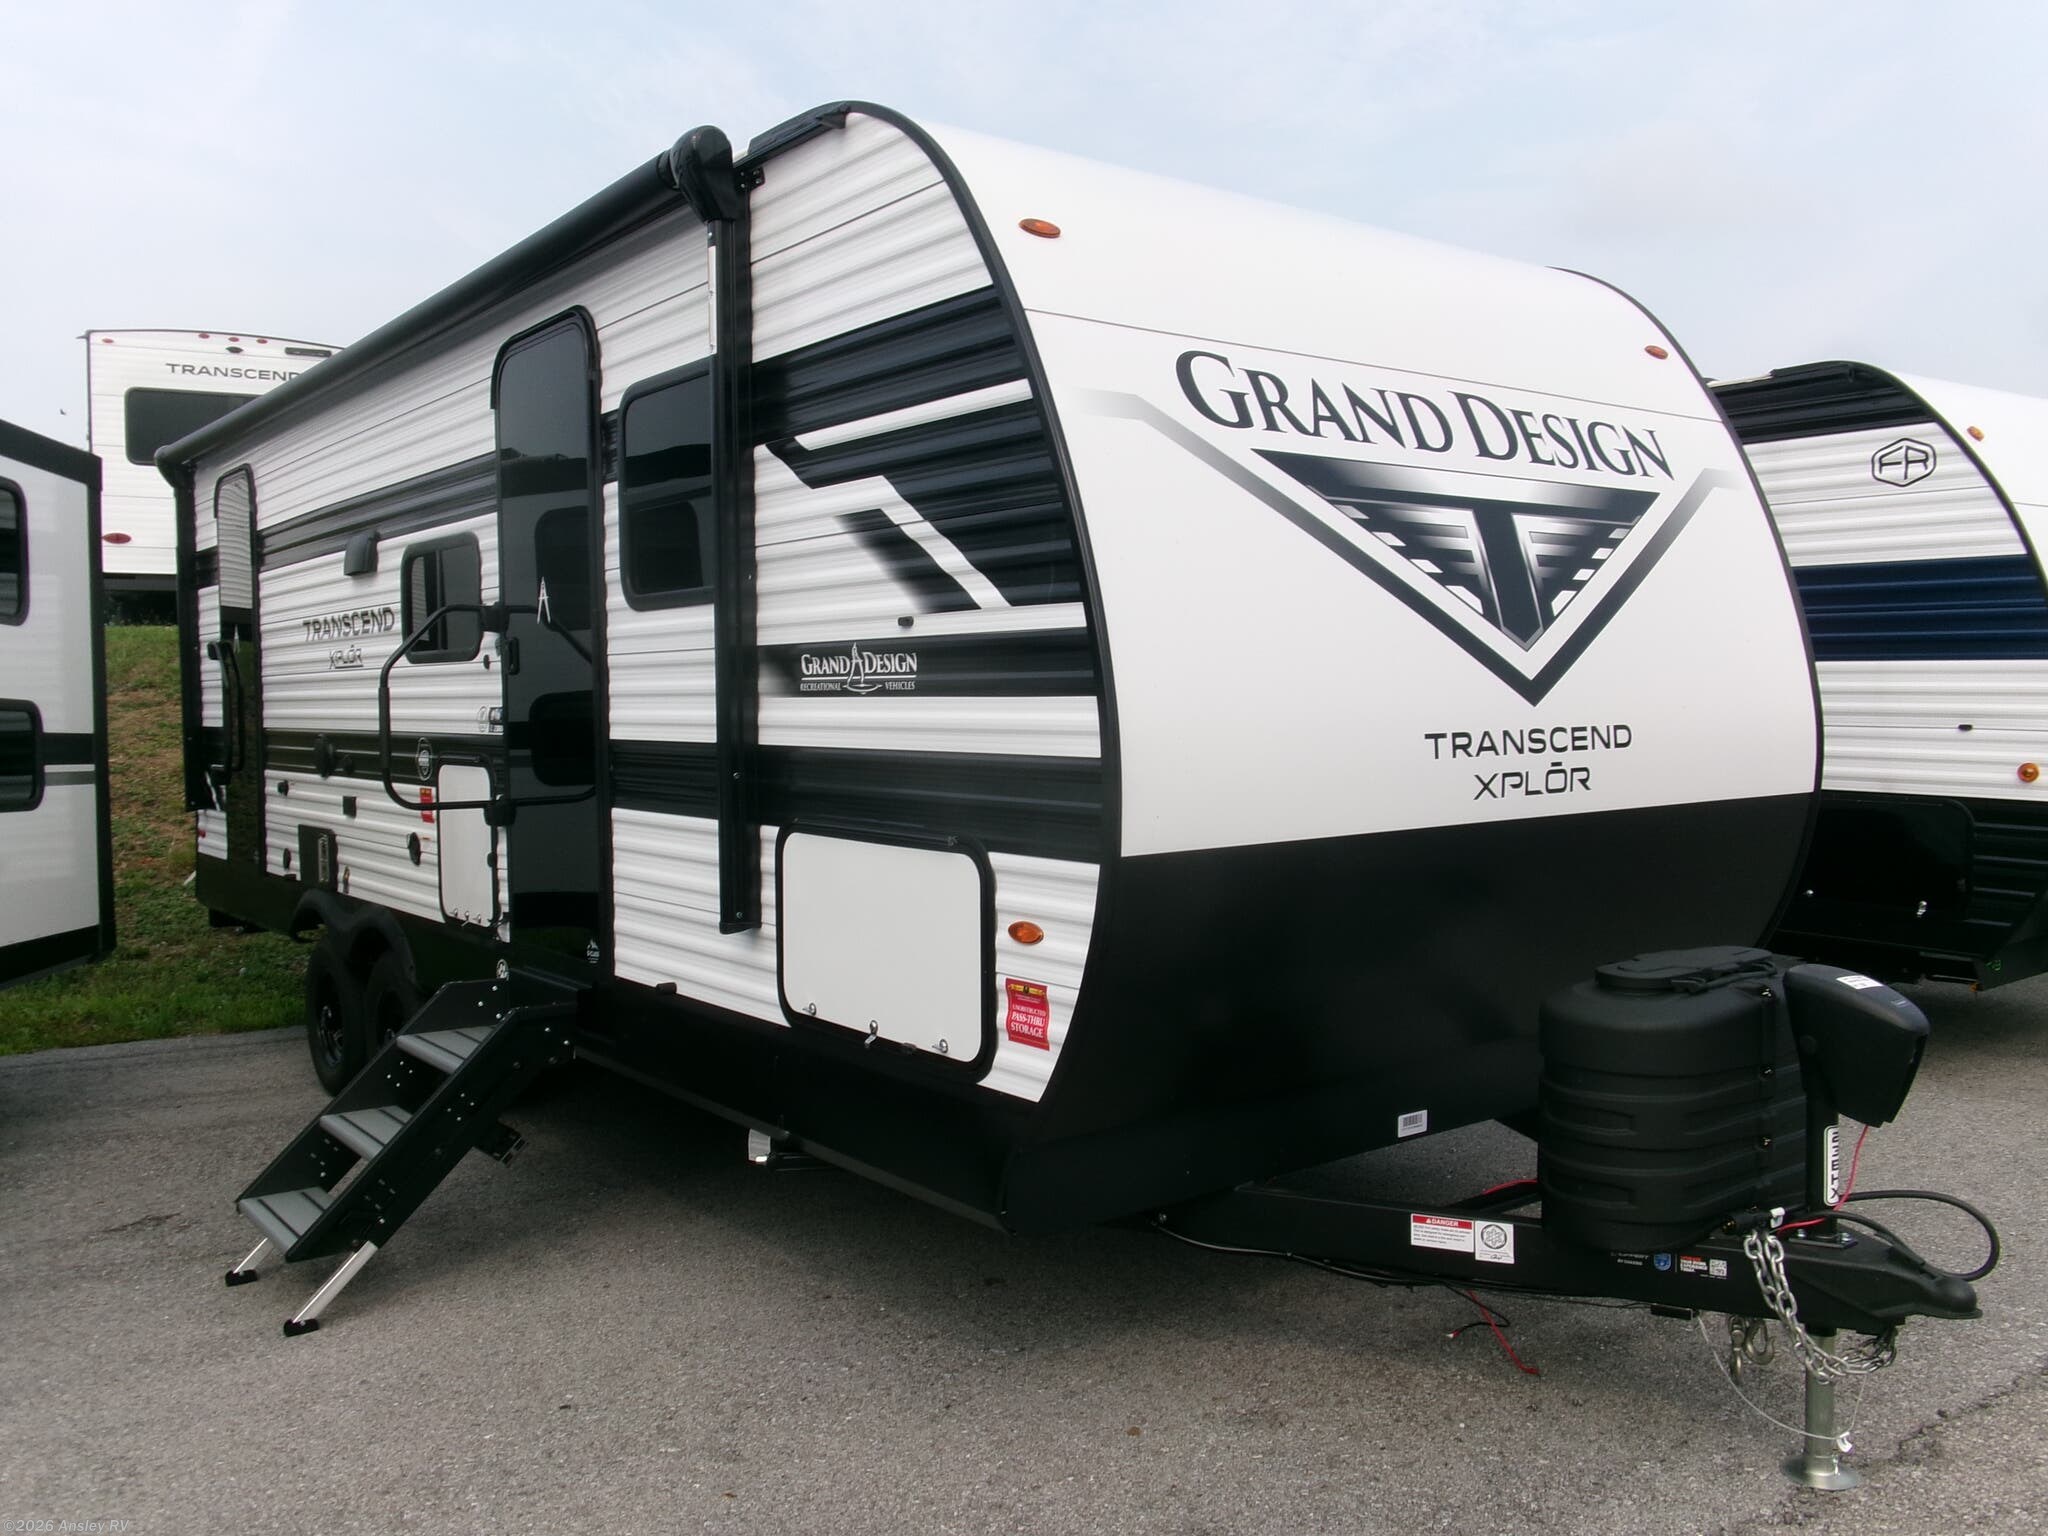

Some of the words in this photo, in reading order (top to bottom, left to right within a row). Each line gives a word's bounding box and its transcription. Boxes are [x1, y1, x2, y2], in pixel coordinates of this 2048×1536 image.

[302, 606, 395, 642] TRANSCEND
[800, 682, 842, 691] RECREATIONAL
[884, 681, 916, 690] VEHICLES
[1424, 724, 1633, 760] TRANSCEND
[1011, 1011, 1046, 1027] PASS-THRU
[1010, 1021, 1044, 1039] STORAGE
[1431, 1219, 1459, 1227] DANGER
